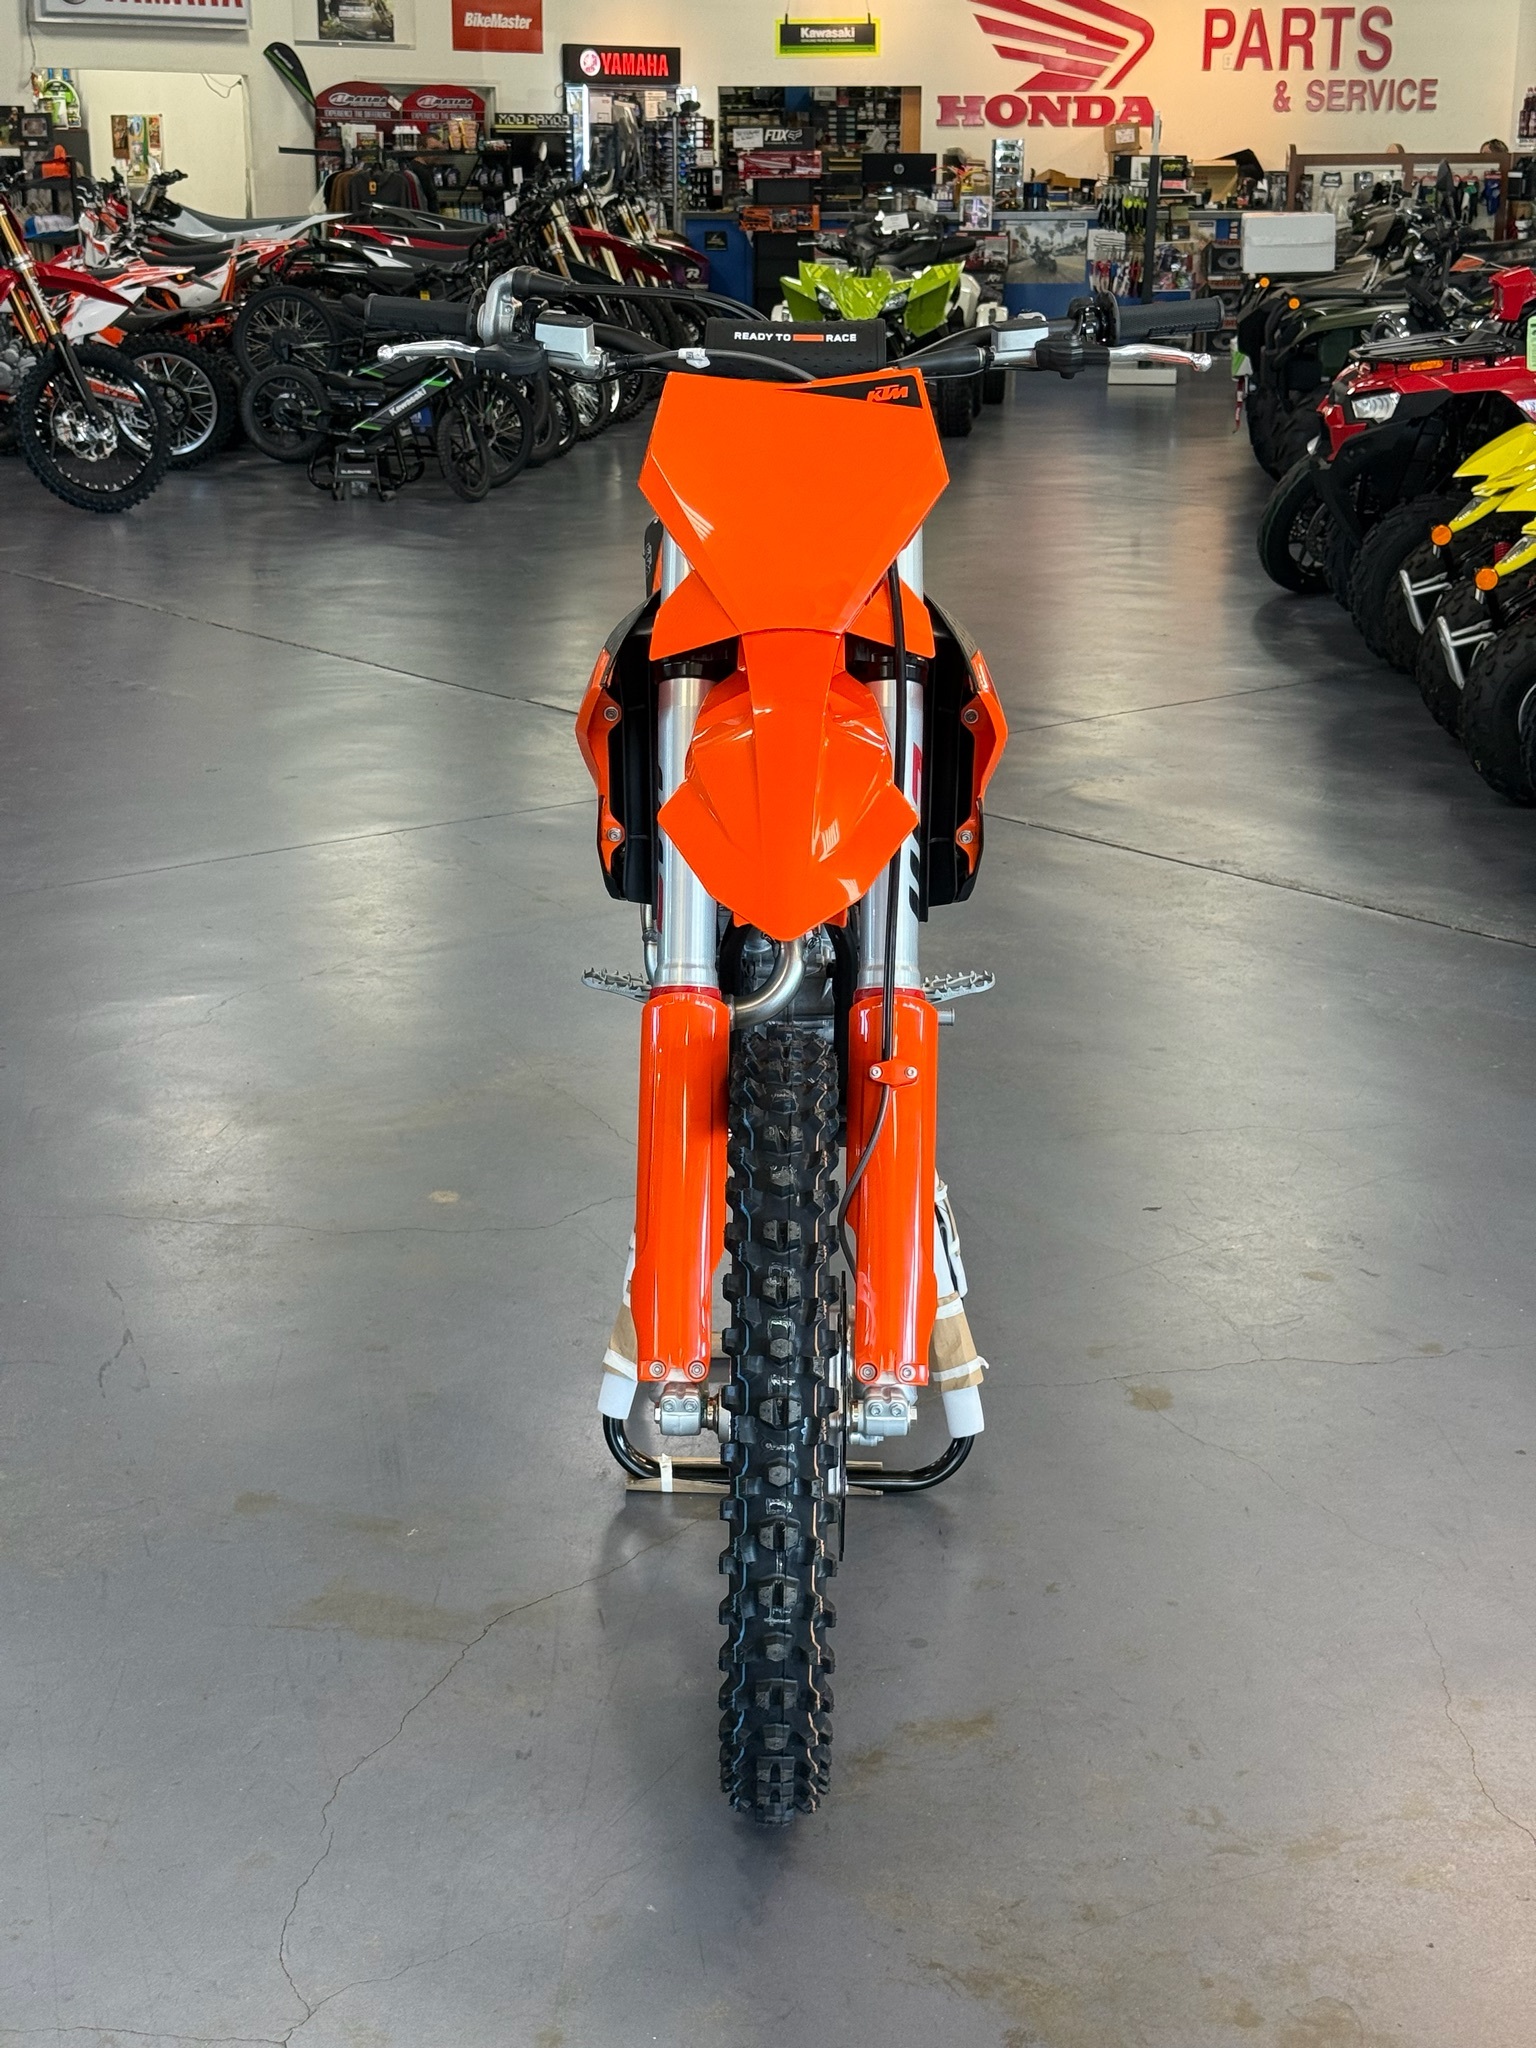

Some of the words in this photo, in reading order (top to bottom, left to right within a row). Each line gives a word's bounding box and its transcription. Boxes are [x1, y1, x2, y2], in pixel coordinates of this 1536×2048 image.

[464, 12, 533, 30] BikeMaster
[800, 27, 855, 38] Kawasaki
[1201, 6, 1393, 72] PARTS
[601, 52, 669, 76] YAMAHA
[1273, 80, 1291, 112] &
[1305, 79, 1438, 112] SERVICE
[936, 94, 1154, 127] HONDA
[498, 114, 525, 125] MOB
[528, 114, 570, 126] ARMOR
[765, 129, 790, 142] FOX
[734, 331, 773, 342] READY
[776, 333, 791, 342] TO
[825, 333, 857, 343] RACE
[388, 387, 427, 417] Kawasaki
[866, 384, 909, 402] KTM
